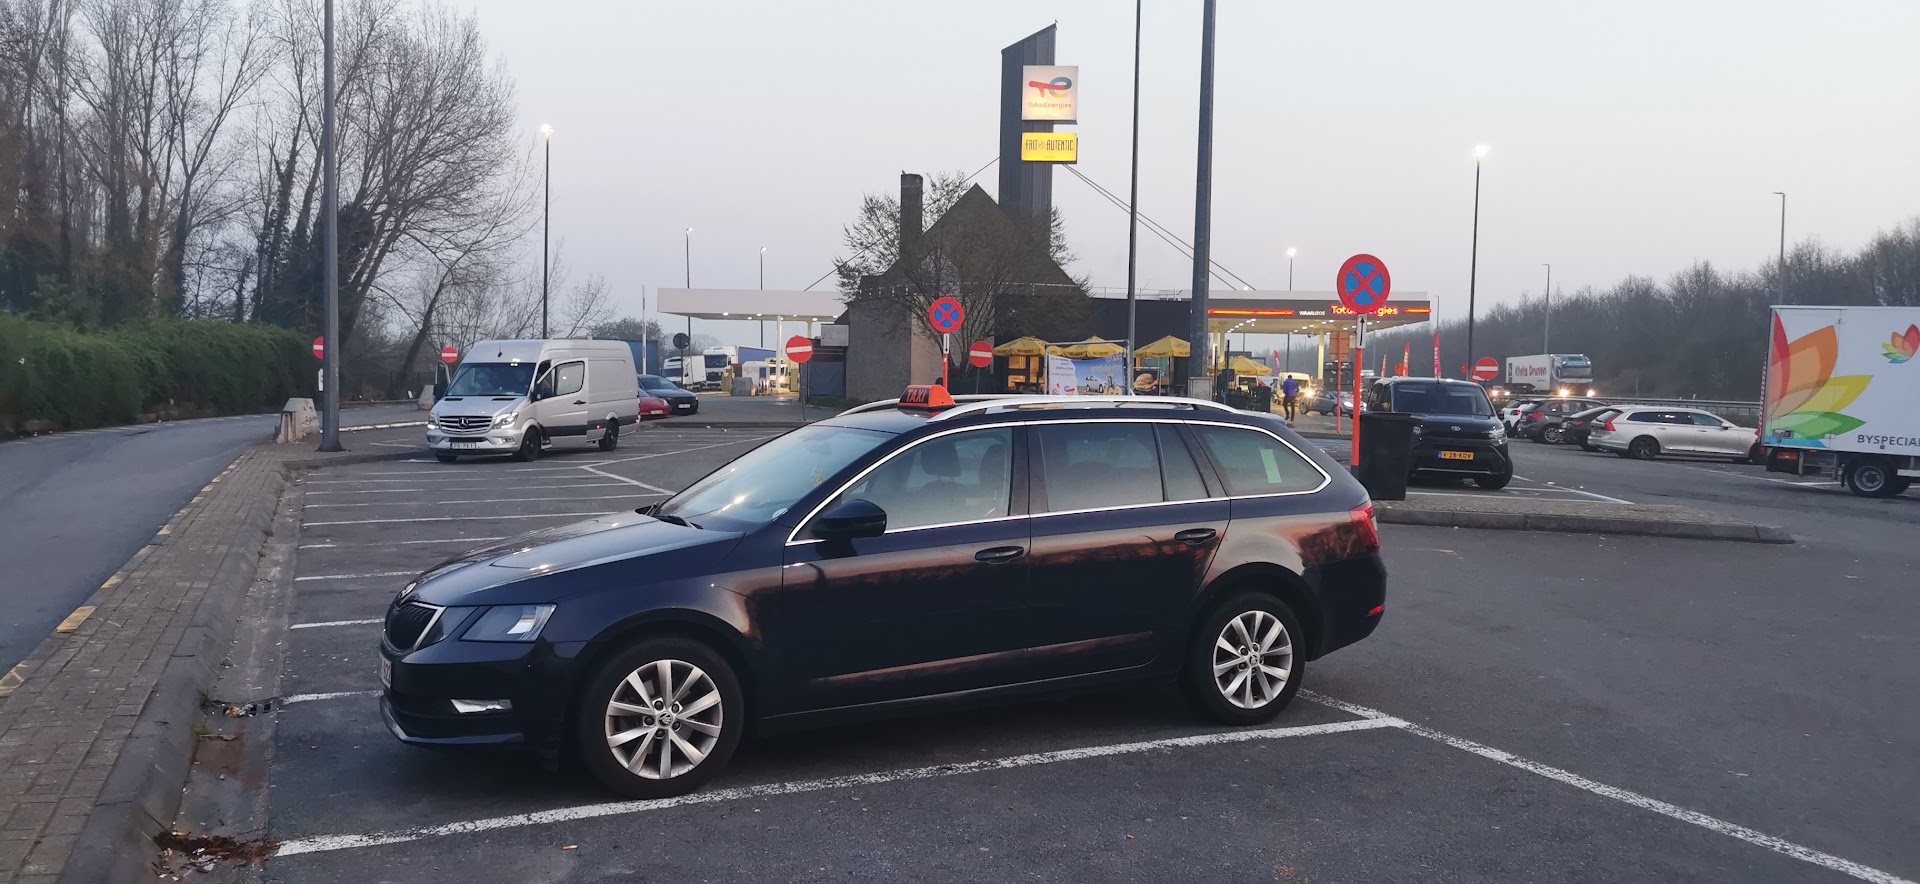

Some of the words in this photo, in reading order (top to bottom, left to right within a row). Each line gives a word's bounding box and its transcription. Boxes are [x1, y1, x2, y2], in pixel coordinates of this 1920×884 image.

[1046, 139, 1074, 151] AUTENTIC
[1331, 305, 1398, 317] Totagies
[906, 388, 928, 402] TAXI
[1857, 434, 1920, 446] BYSPECIA
